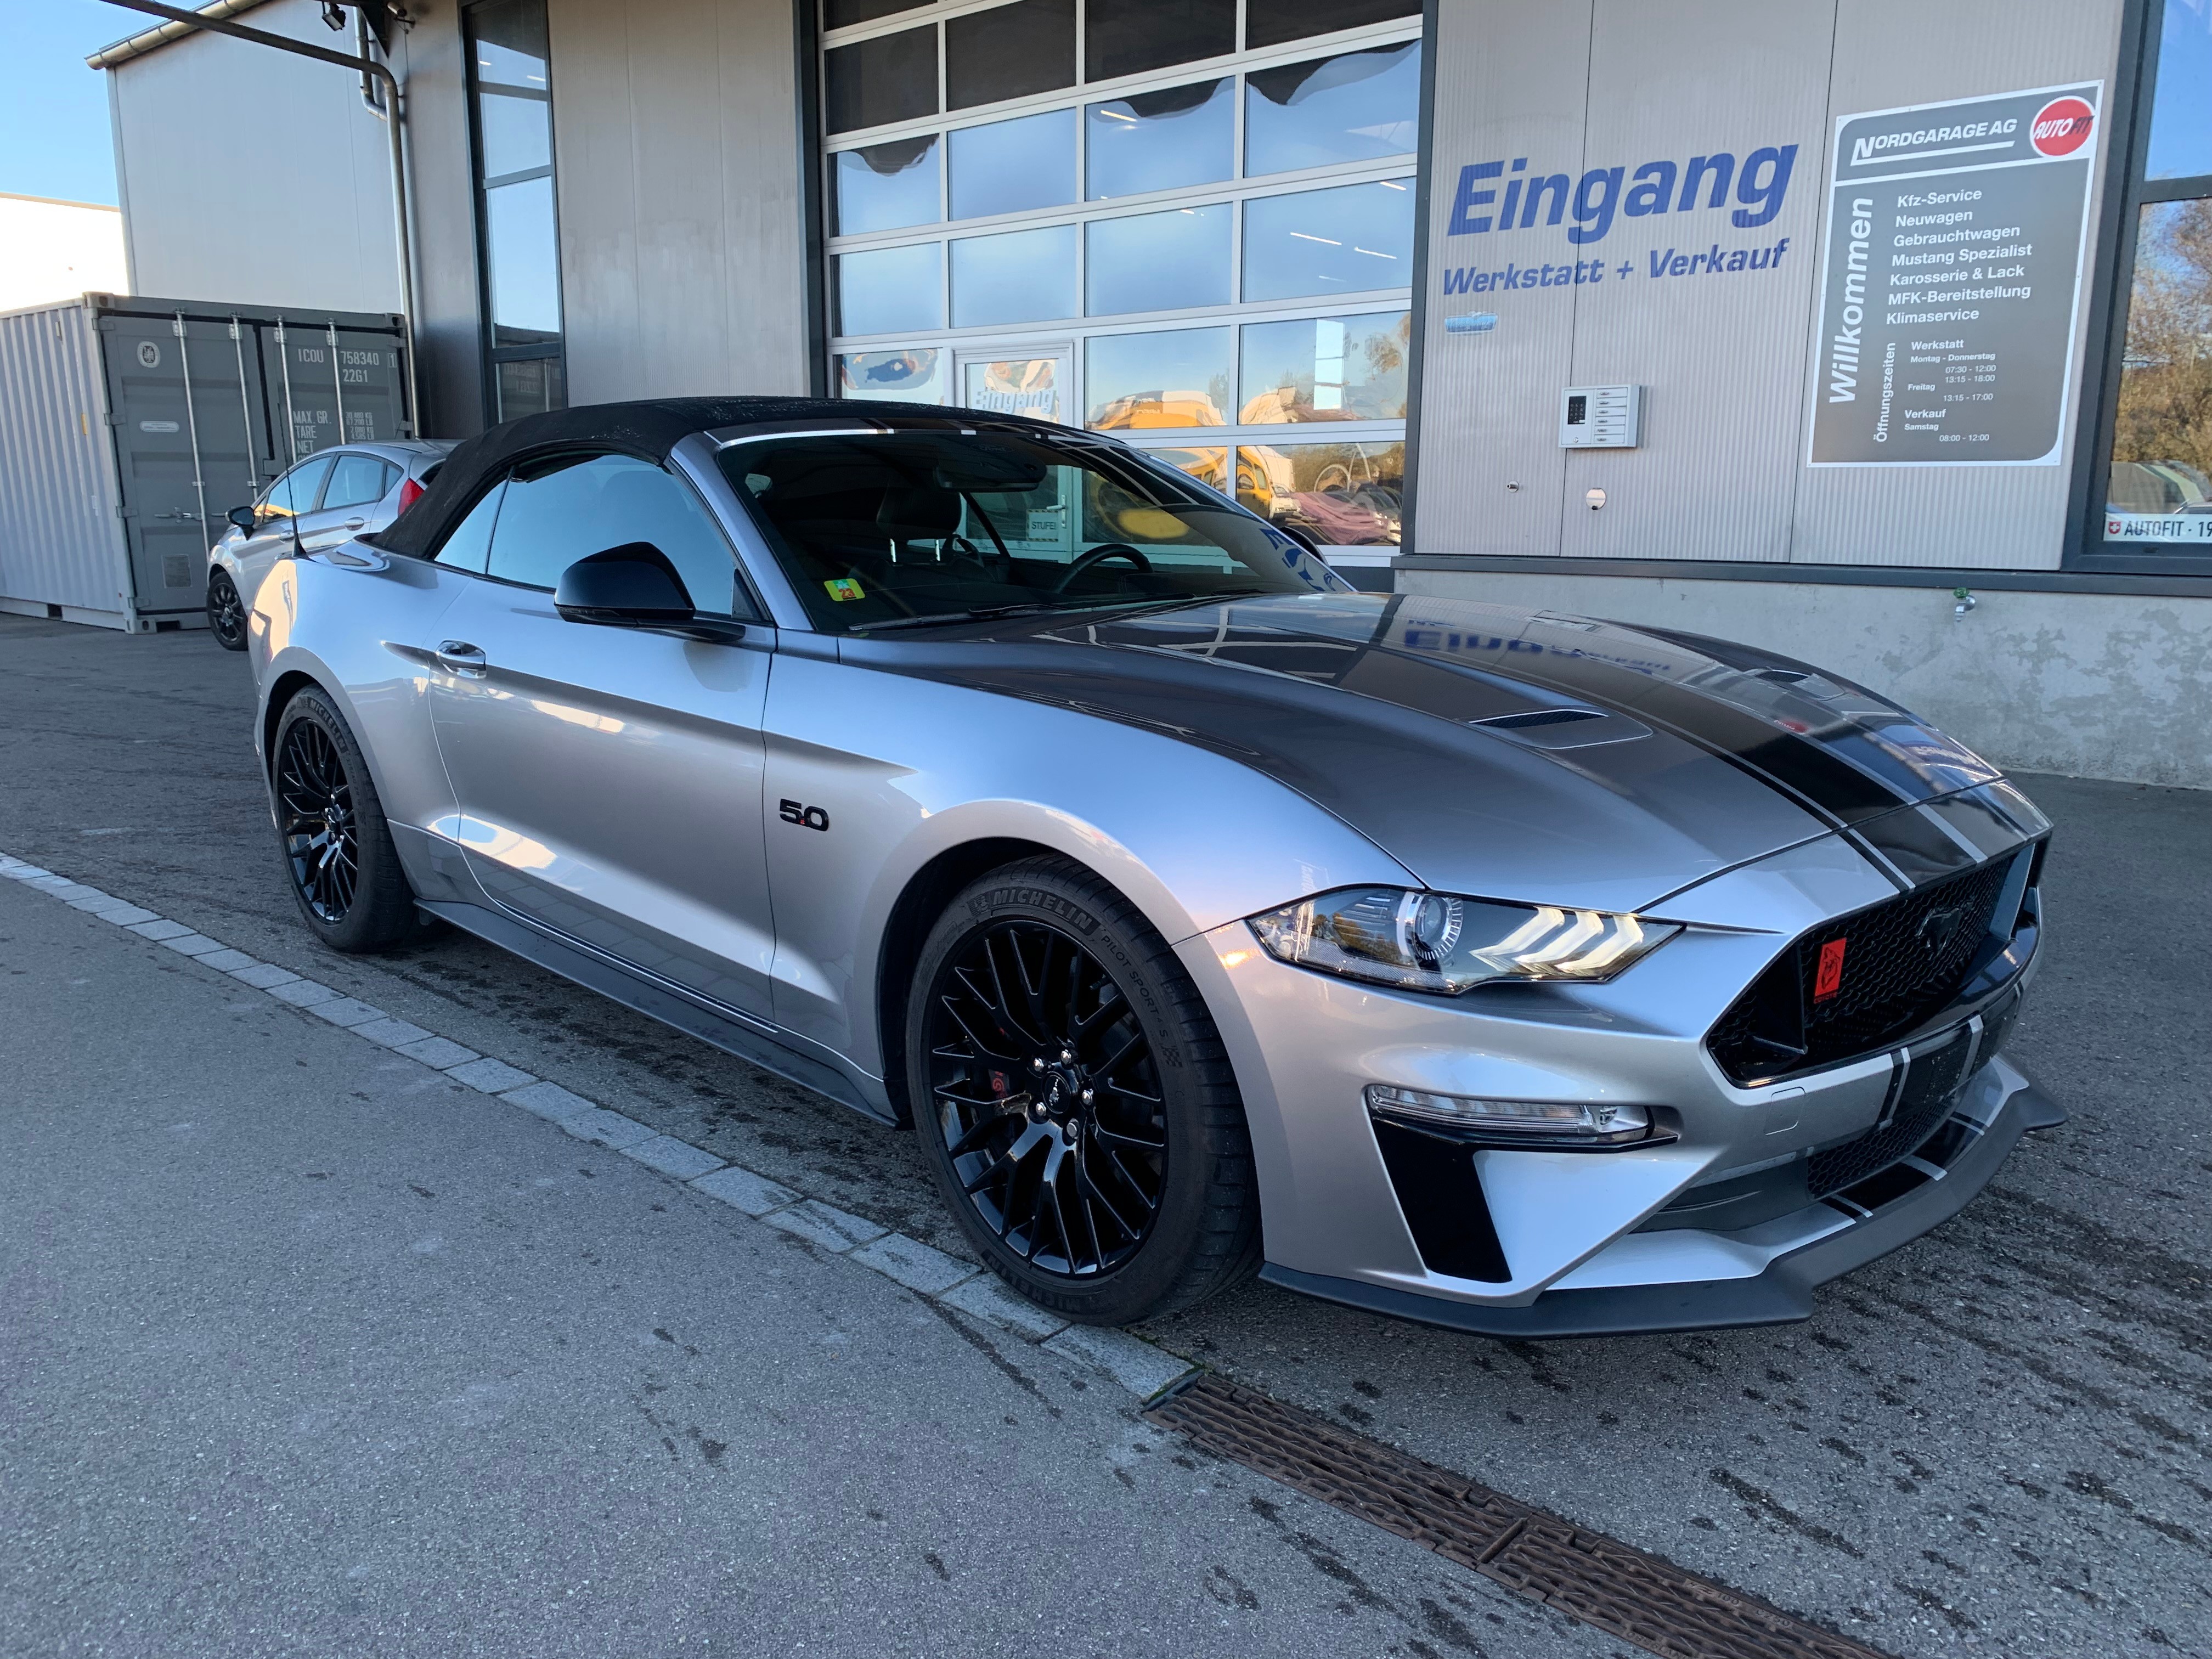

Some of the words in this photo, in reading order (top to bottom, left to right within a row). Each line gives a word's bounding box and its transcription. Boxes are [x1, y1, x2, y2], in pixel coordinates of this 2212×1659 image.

[2034, 115, 2095, 139] AUTOFIT
[1855, 122, 1987, 160] NORDGARAGE
[1988, 119, 2018, 136] AG
[1447, 144, 1799, 246] Eingang
[1897, 188, 1983, 208] Kfz-Service
[1895, 211, 1973, 228] Neuwagen
[1893, 224, 2021, 248] Gebrauchtwagen
[1891, 251, 1955, 268] Mustang
[1958, 243, 2033, 264] Spezialist
[1443, 258, 1605, 296] Werkstatt
[1616, 260, 1634, 280] +
[1649, 237, 1791, 279] Verkauf
[1889, 268, 1968, 286] Karosserie
[1971, 267, 1984, 280] &
[1987, 264, 2025, 279] Lack
[1829, 198, 1874, 403] Willkommen
[1887, 283, 2032, 306] MFK-Bereitstellung
[1886, 308, 1980, 325] Klimaservice
[1911, 339, 1965, 351] Werkstatt
[298, 348, 324, 363] ICOU
[340, 351, 380, 366] 758340
[388, 354, 396, 368] 1
[1910, 355, 1941, 364] Montag
[1948, 352, 1996, 362] Donnerstag
[342, 369, 368, 383] 22G1
[1945, 365, 1967, 374] 07:30
[1974, 364, 1997, 373] 12:00
[1945, 375, 1966, 383] 13:15
[1974, 374, 1996, 383] 18:00
[1873, 342, 1896, 443] Öffnungszeiten
[1908, 383, 1936, 392] Freitag
[1943, 393, 1965, 402] 13:15
[1972, 392, 1994, 401] 17:00
[1904, 408, 1946, 419] Verkauf
[295, 425, 317, 438] TARE
[1904, 423, 1939, 432] Samstag
[1939, 434, 1961, 443] 08:00
[1968, 433, 1990, 442] 12:00
[297, 441, 314, 453] NET
[2124, 521, 2184, 536] AUTOFIT
[838, 588, 855, 598] 23
[309, 699, 346, 747] MICHELIN
[992, 889, 1093, 930] MICHELIN
[1101, 934, 1131, 967] PILOT
[1129, 970, 1159, 1014] SPORT
[1159, 1029, 1169, 1037] S
